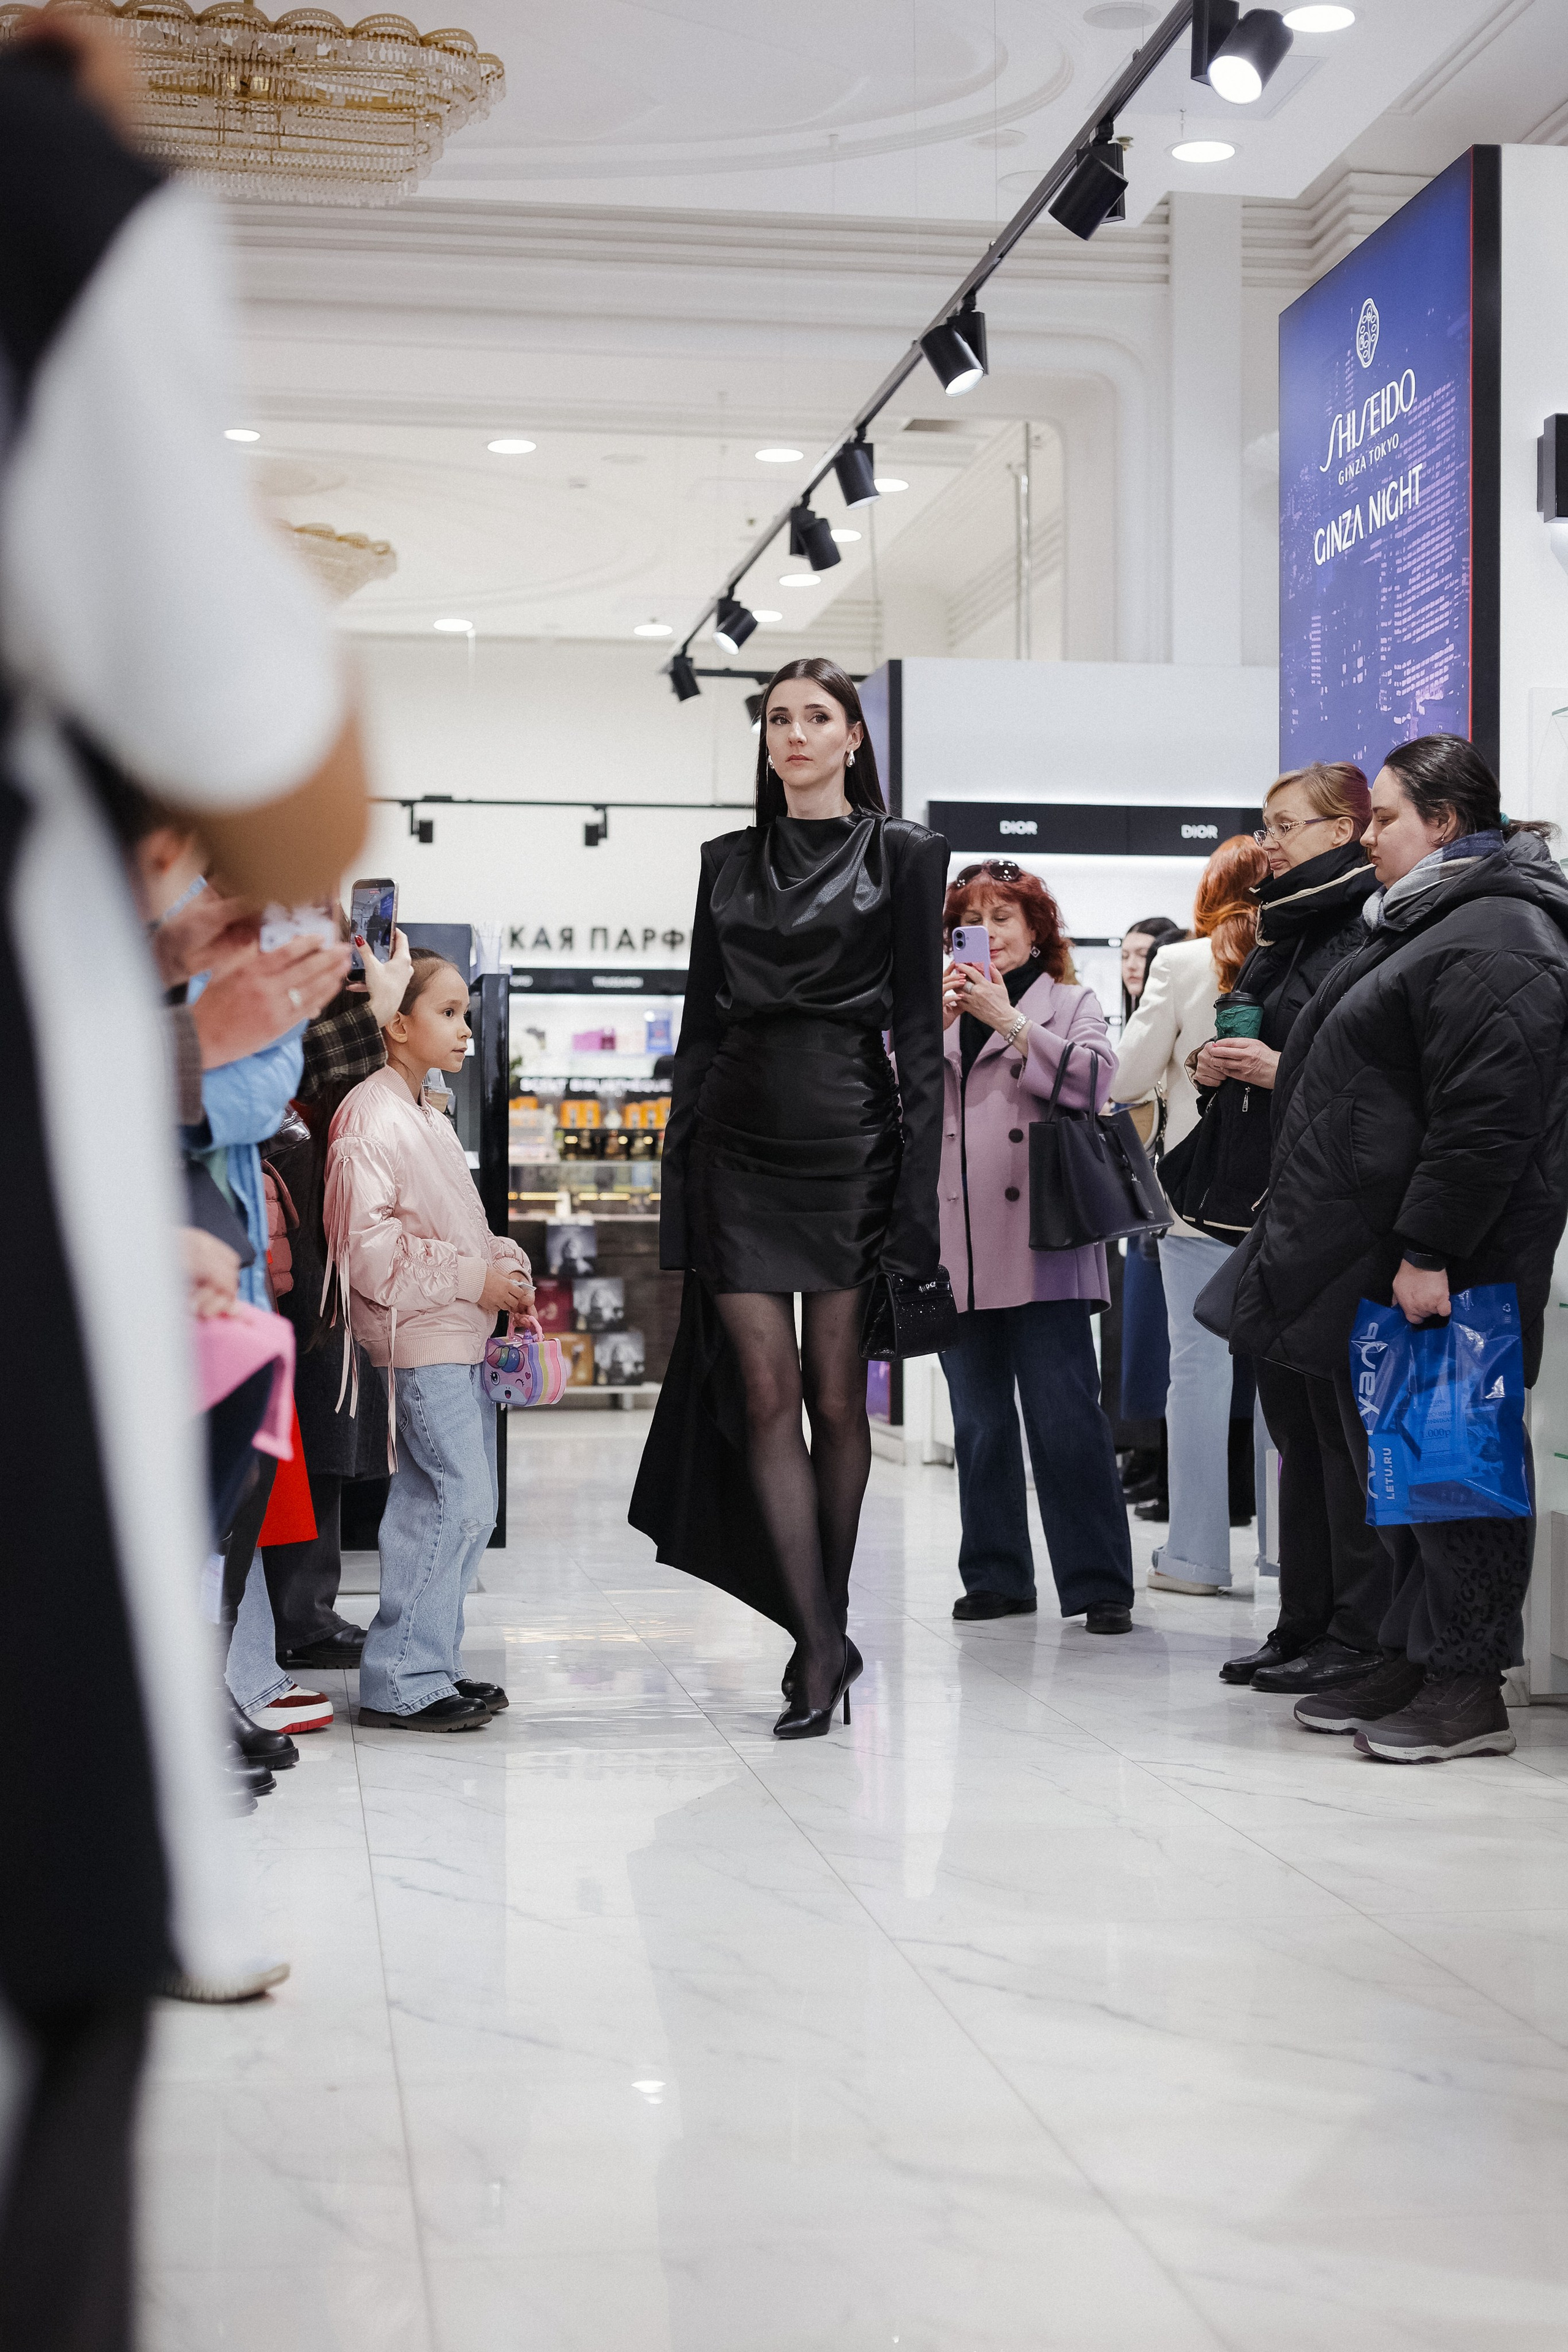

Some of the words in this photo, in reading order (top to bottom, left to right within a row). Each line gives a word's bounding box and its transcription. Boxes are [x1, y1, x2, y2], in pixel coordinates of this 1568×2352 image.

[1319, 369, 1415, 473] SHISEIDO
[1338, 461, 1366, 486] GINZA
[1369, 433, 1400, 466] TOKYO
[1313, 504, 1363, 567] GINZA
[1368, 463, 1423, 534] NIGHT
[999, 820, 1038, 835] DIOR
[1181, 824, 1218, 839] DIOR
[508, 926, 573, 951] КАЯ
[590, 927, 693, 951] ПАРФ
[1382, 1447, 1396, 1500] LETU.RU
